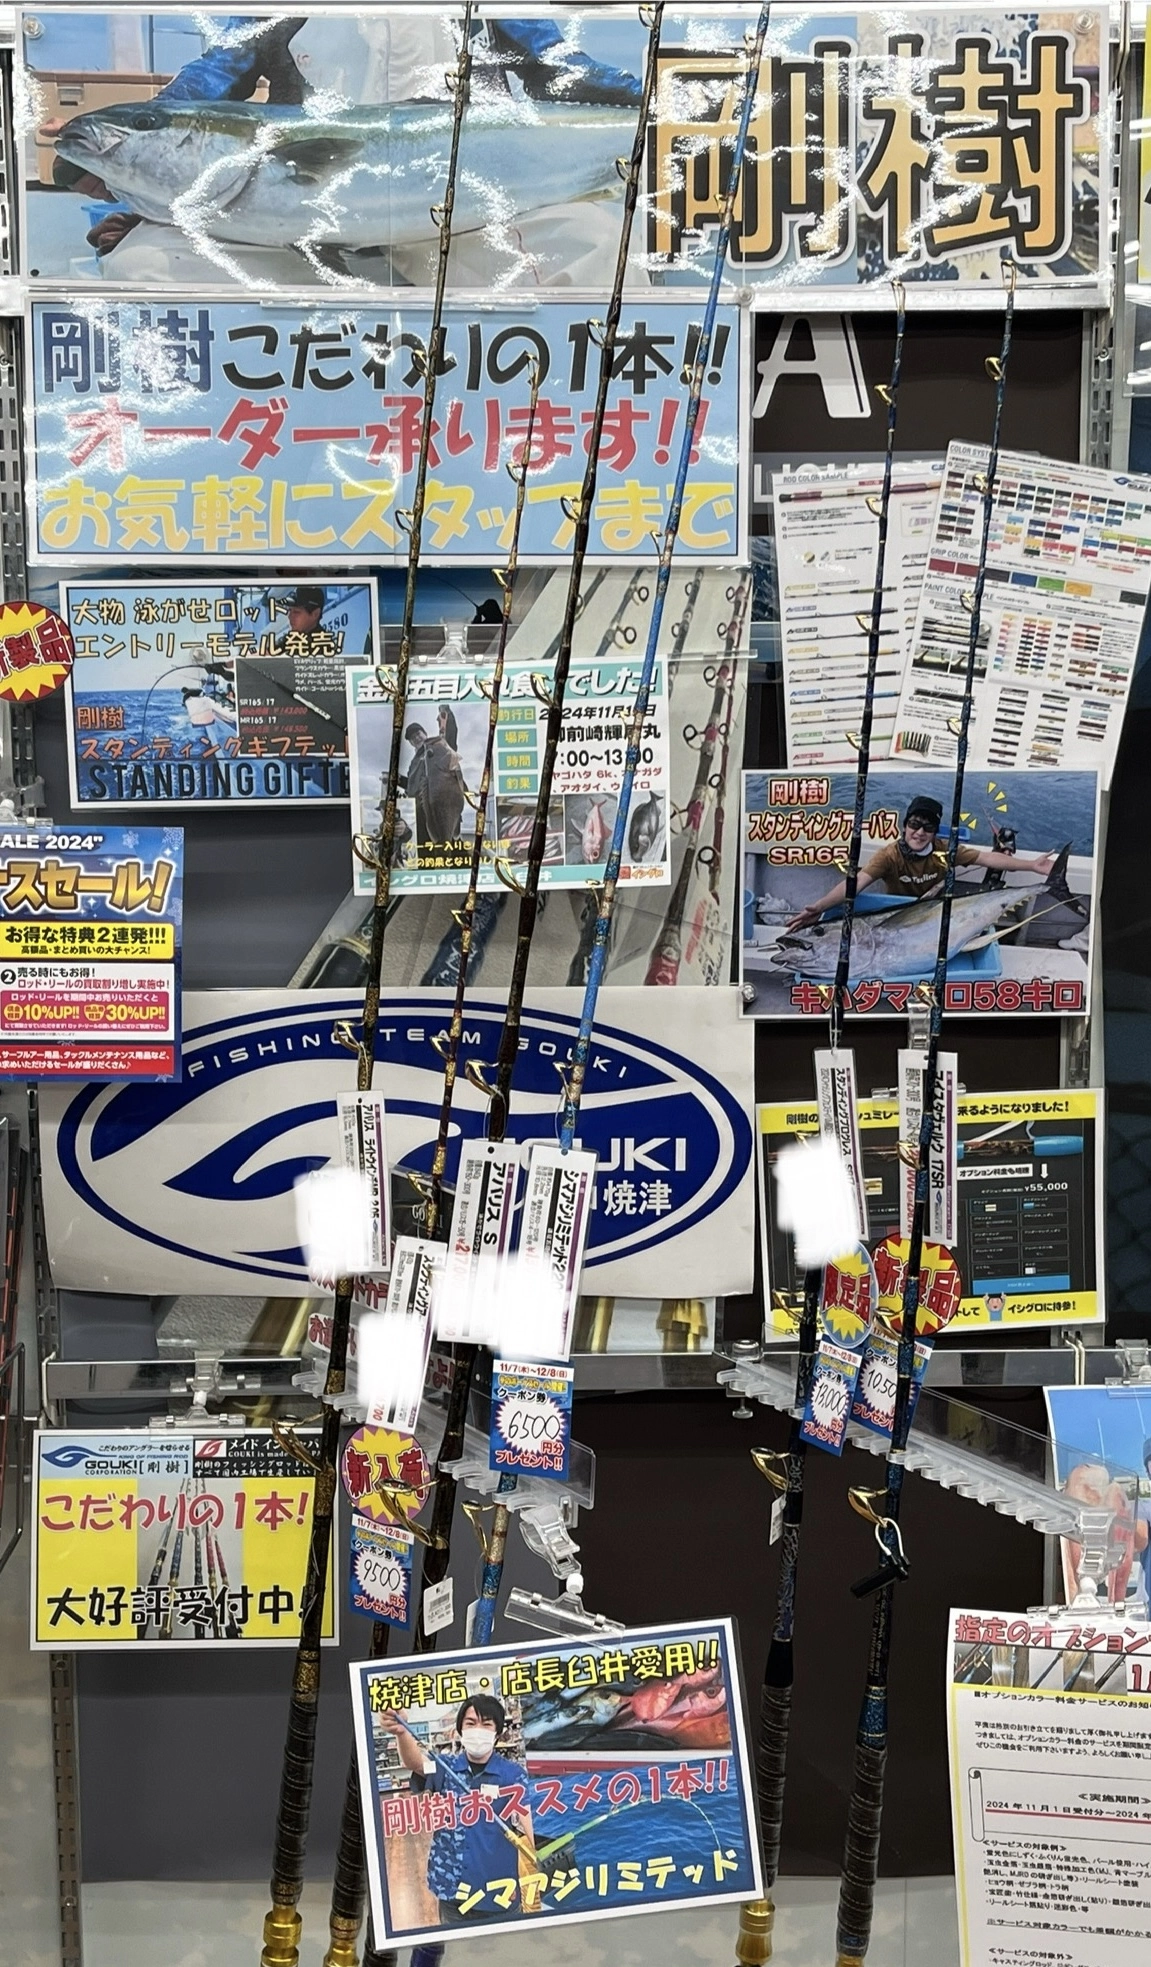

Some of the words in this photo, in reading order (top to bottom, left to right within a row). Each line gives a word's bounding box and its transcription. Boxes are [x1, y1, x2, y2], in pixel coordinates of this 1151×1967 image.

[647, 35, 1086, 264] 剛樹
[41, 309, 731, 394] 剛樹こだわりの1本!!
[67, 395, 710, 473] オーダー承ります!!
[972, 448, 992, 458] SYST
[41, 474, 734, 552] お気軽にスタッフまで
[73, 598, 124, 625] 大物
[134, 597, 288, 625] 泳がせロッド
[0, 615, 73, 678] 製品
[75, 631, 345, 660] エントリーモデル発売!
[77, 706, 124, 730] 剛樹
[539, 704, 657, 720] 224年11月1日
[505, 731, 530, 743] 場所
[506, 755, 531, 767] 時間
[89, 762, 254, 798] STANDING
[506, 776, 531, 789] 釣果
[770, 778, 829, 805] 剛樹
[748, 810, 900, 841] スタンディングアーバス
[769, 846, 851, 865] SR165
[0, 860, 173, 913] スセール!
[5, 926, 166, 944] お得な特典2連発!!!
[17, 967, 96, 978] 売る時にもお得!
[790, 979, 1084, 1013] キハダマロ58キロ
[24, 1003, 80, 1021] 10%UP!!
[105, 1004, 166, 1021] 30%UP!!
[187, 1031, 349, 1077] FISHING
[379, 1028, 481, 1045] TEAM
[931, 1159, 945, 1189] 17SR
[1024, 1182, 1068, 1192] ¥55,000
[603, 1178, 673, 1217] 焼津
[1007, 1301, 1076, 1314] イシグロに持参!
[865, 1348, 898, 1370] クーポン
[507, 1410, 561, 1440] 6500
[229, 1439, 258, 1450] メイド
[85, 1460, 138, 1469] GOUKI
[347, 1448, 424, 1498] 新入荷
[495, 1450, 563, 1471] プレゼント!!
[40, 1491, 309, 1532] こだわりの1本!
[363, 1558, 401, 1592] 9500
[46, 1585, 304, 1627] 大好評受付中
[369, 1639, 719, 1713] 焼津店・店長臼井愛用!!
[382, 1759, 730, 1838] 剛樹おススメの1本!!
[987, 1801, 1009, 1809] 2024
[1040, 1805, 1049, 1813] 月
[454, 1848, 740, 1917] シマアジリミテッド
